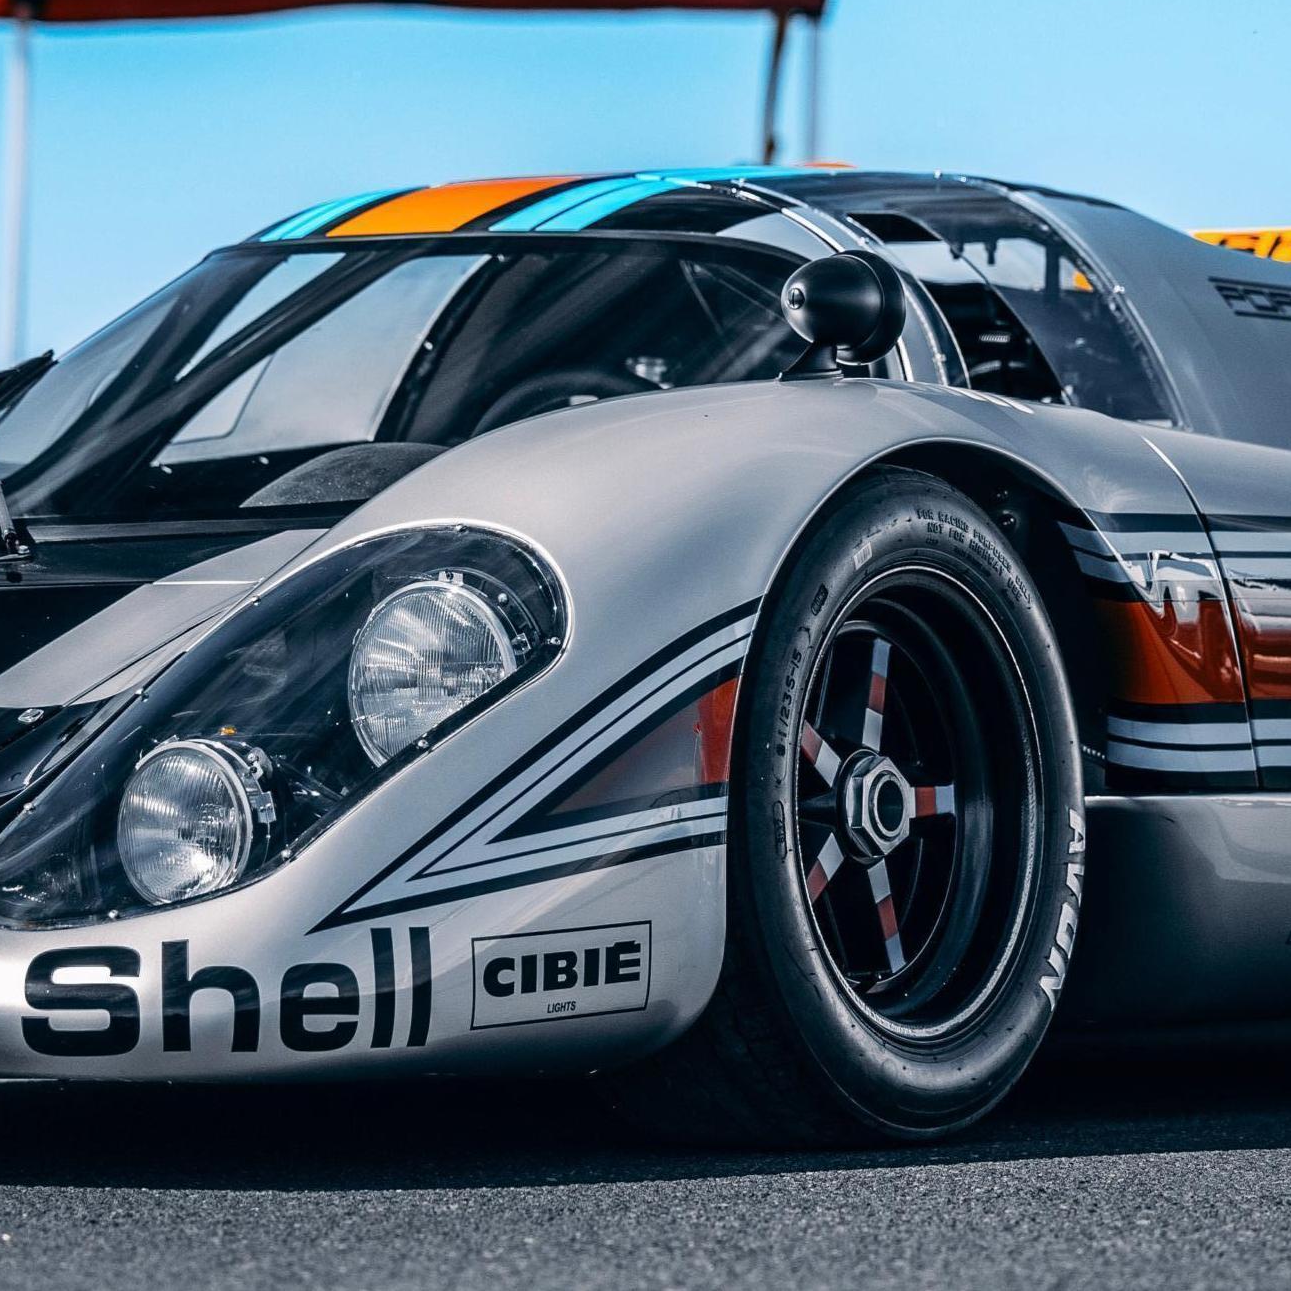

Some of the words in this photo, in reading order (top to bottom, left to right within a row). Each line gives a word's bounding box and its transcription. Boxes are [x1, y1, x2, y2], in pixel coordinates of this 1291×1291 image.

[1039, 809, 1086, 1012] AVON
[21, 926, 433, 1057] Shell
[547, 1001, 576, 1014] LIGHTS
